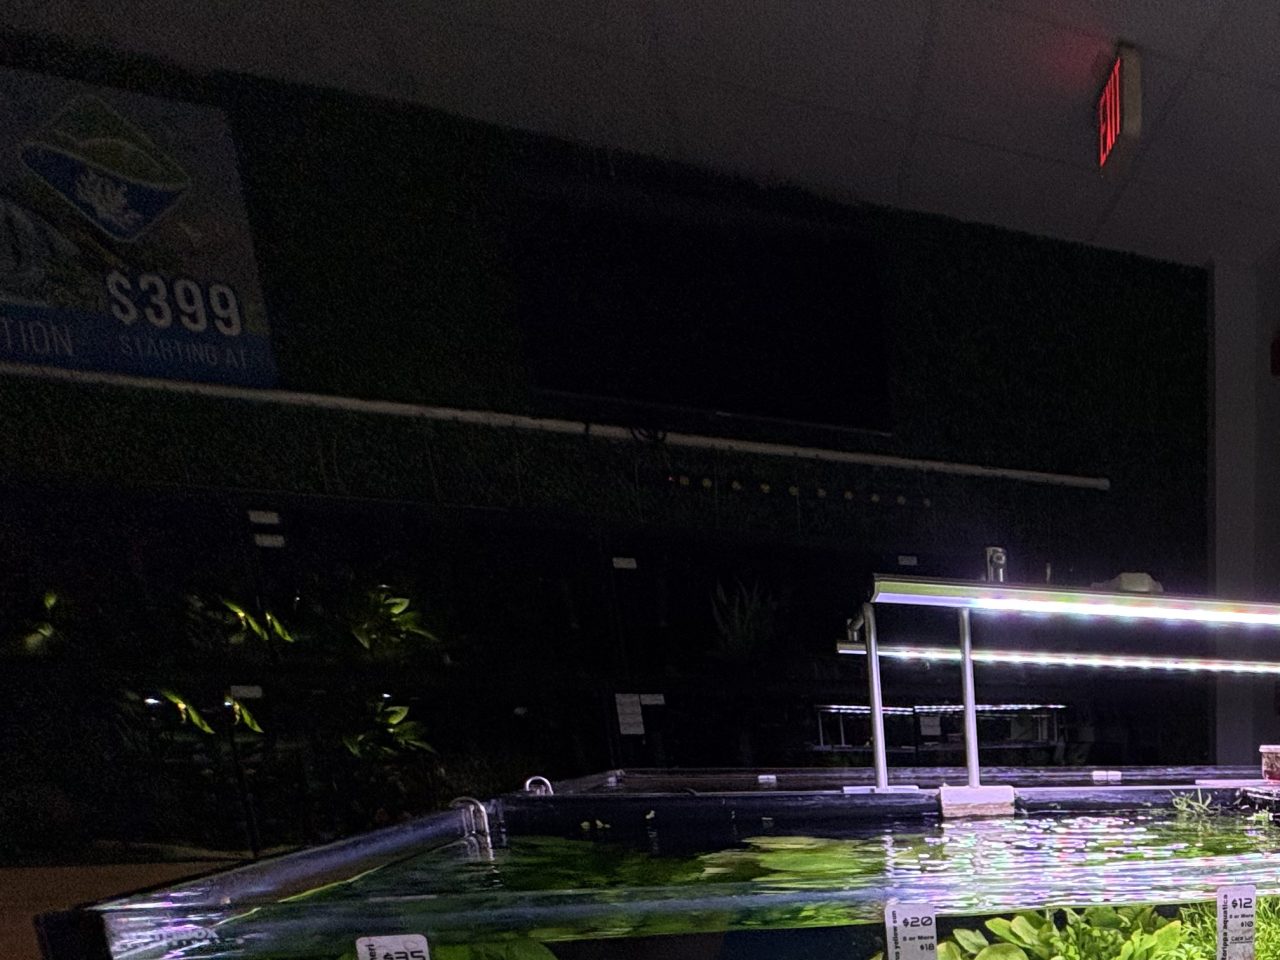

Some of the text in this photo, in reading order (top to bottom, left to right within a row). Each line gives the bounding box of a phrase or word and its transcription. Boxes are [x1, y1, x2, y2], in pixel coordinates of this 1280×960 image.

[106, 270, 242, 336] $399
[120, 334, 218, 366] STARTING
[1232, 898, 1252, 909] $12
[903, 916, 933, 927] $20
[920, 943, 934, 951] $18
